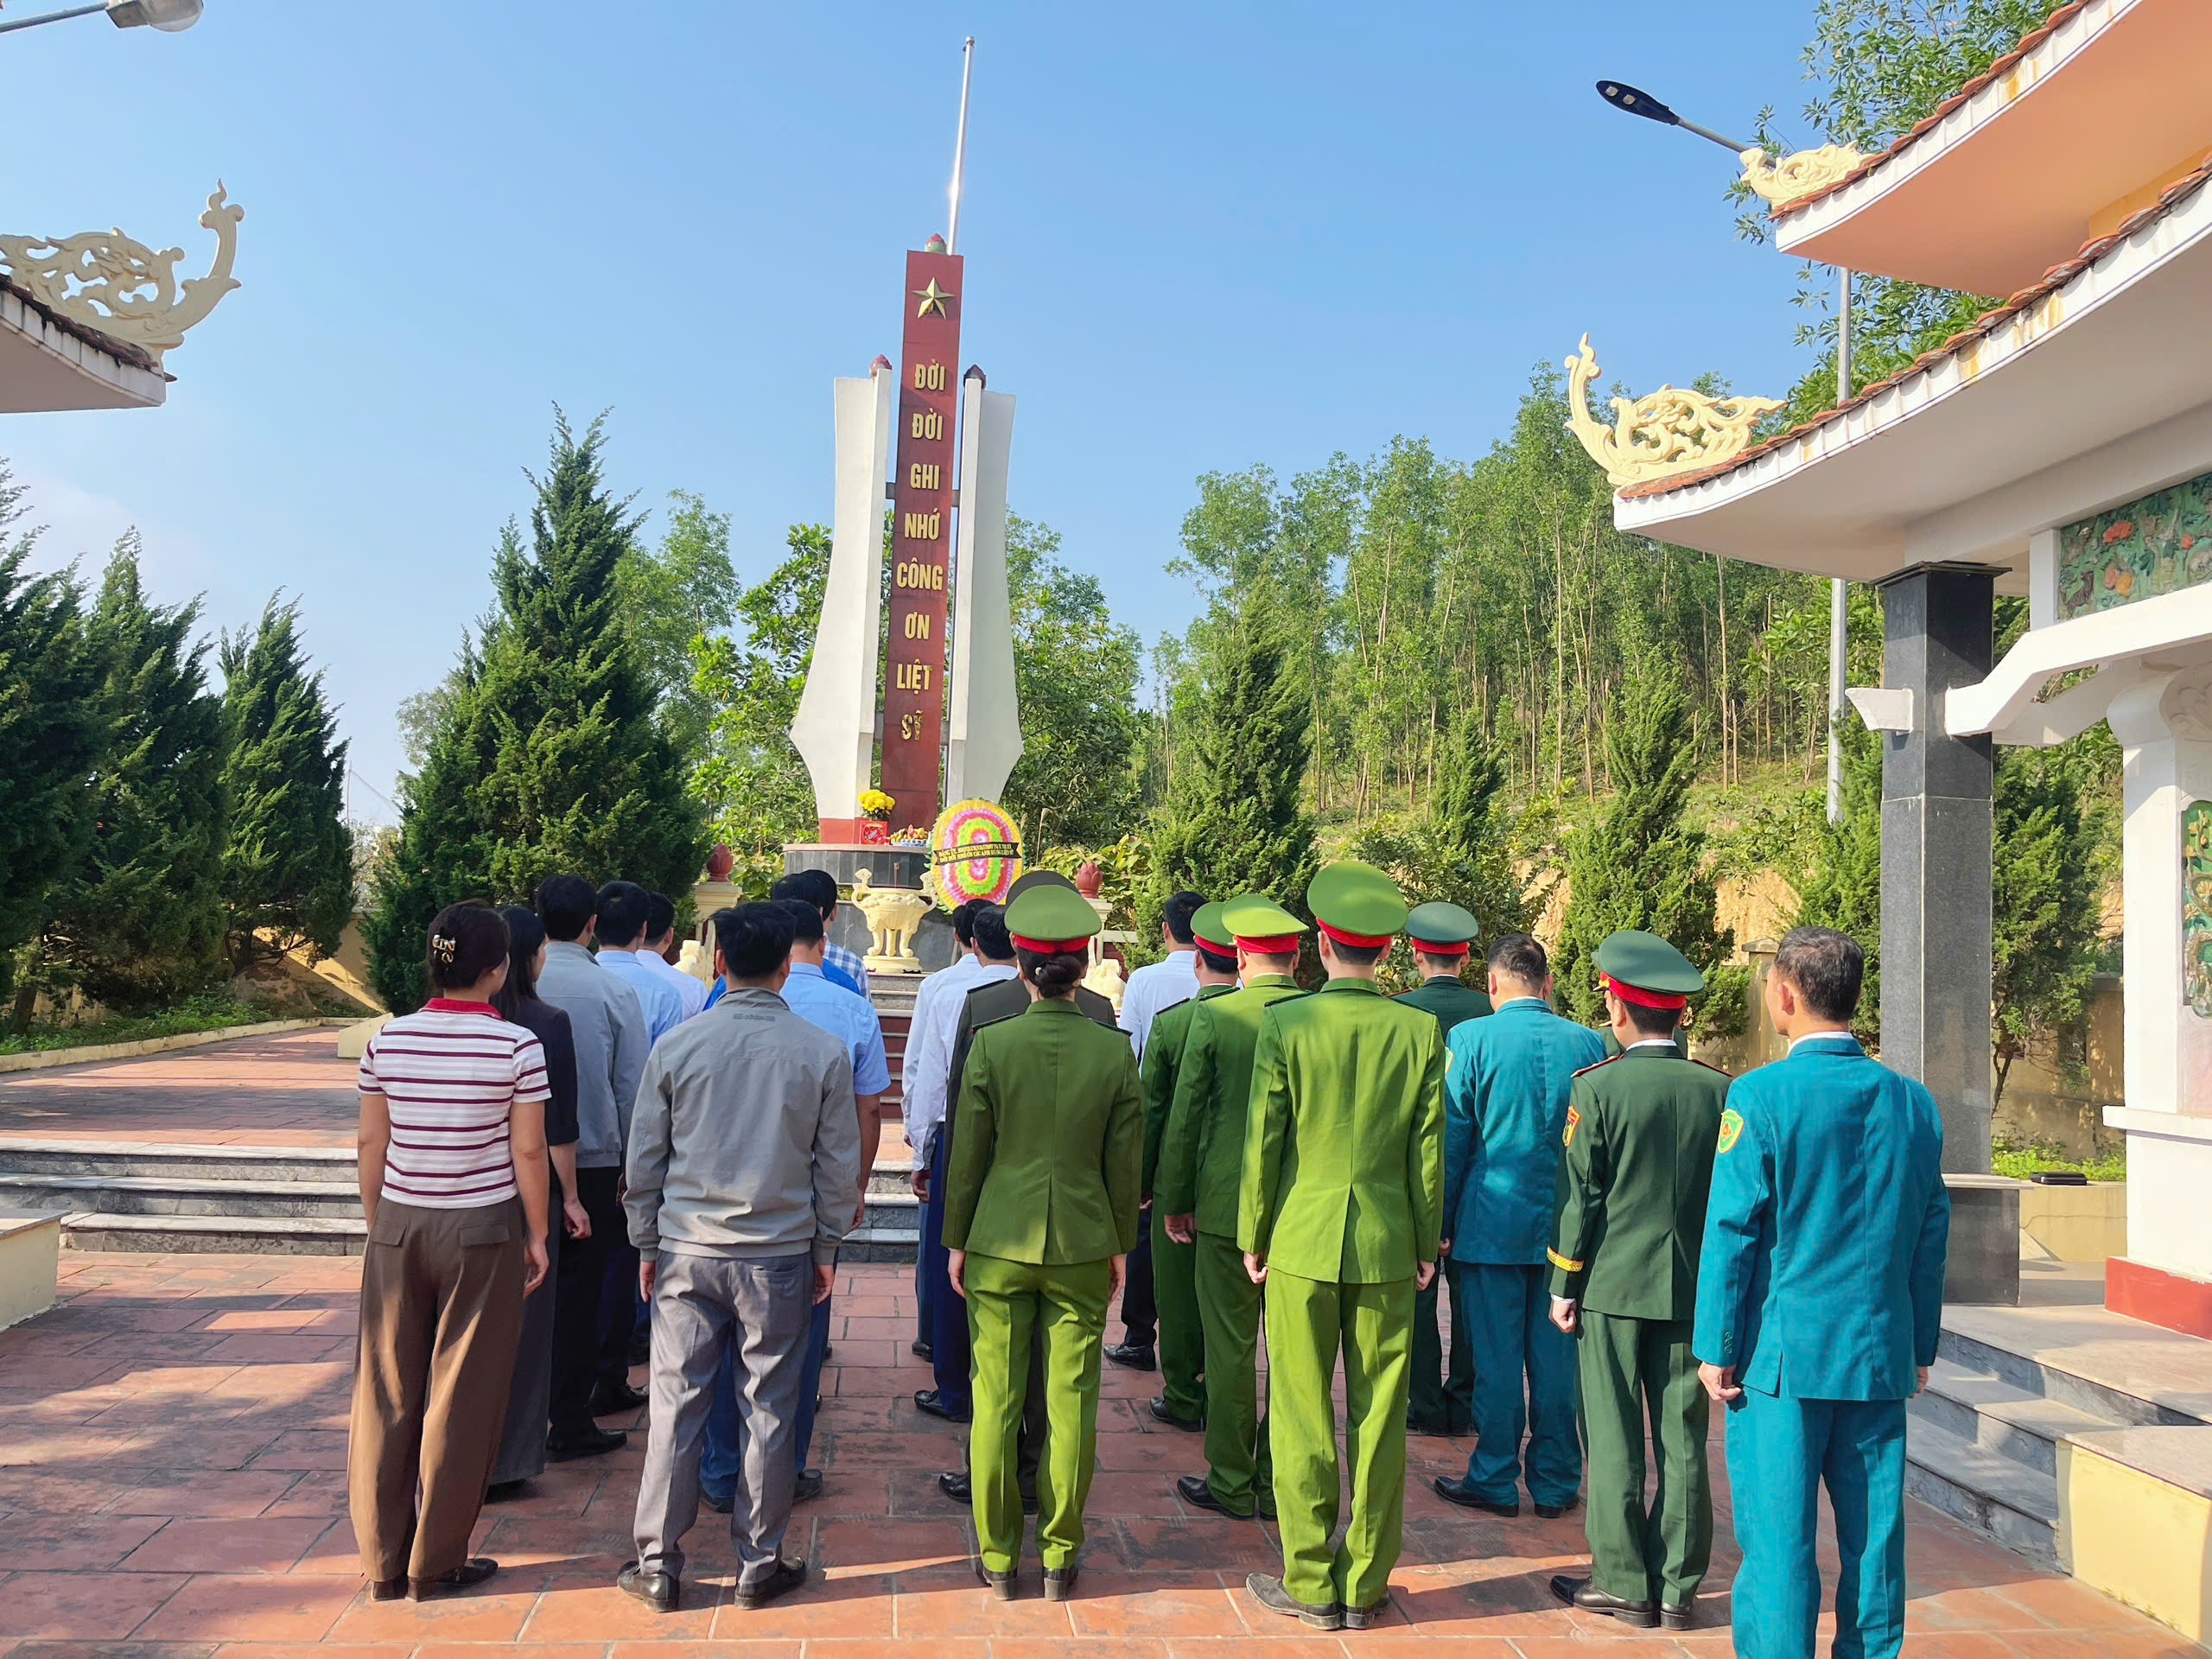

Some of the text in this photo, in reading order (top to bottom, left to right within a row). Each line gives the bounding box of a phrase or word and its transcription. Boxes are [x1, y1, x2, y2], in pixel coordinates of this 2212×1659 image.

[914, 359, 946, 391] ĐỜI
[912, 408, 944, 441] ĐỜI
[910, 463, 940, 491] GHI
[905, 508, 941, 541] NHỚ
[896, 557, 944, 591] CÔNG
[905, 612, 931, 640] ƠN
[896, 658, 933, 695] LIỆT
[900, 709, 924, 741] SĨ
